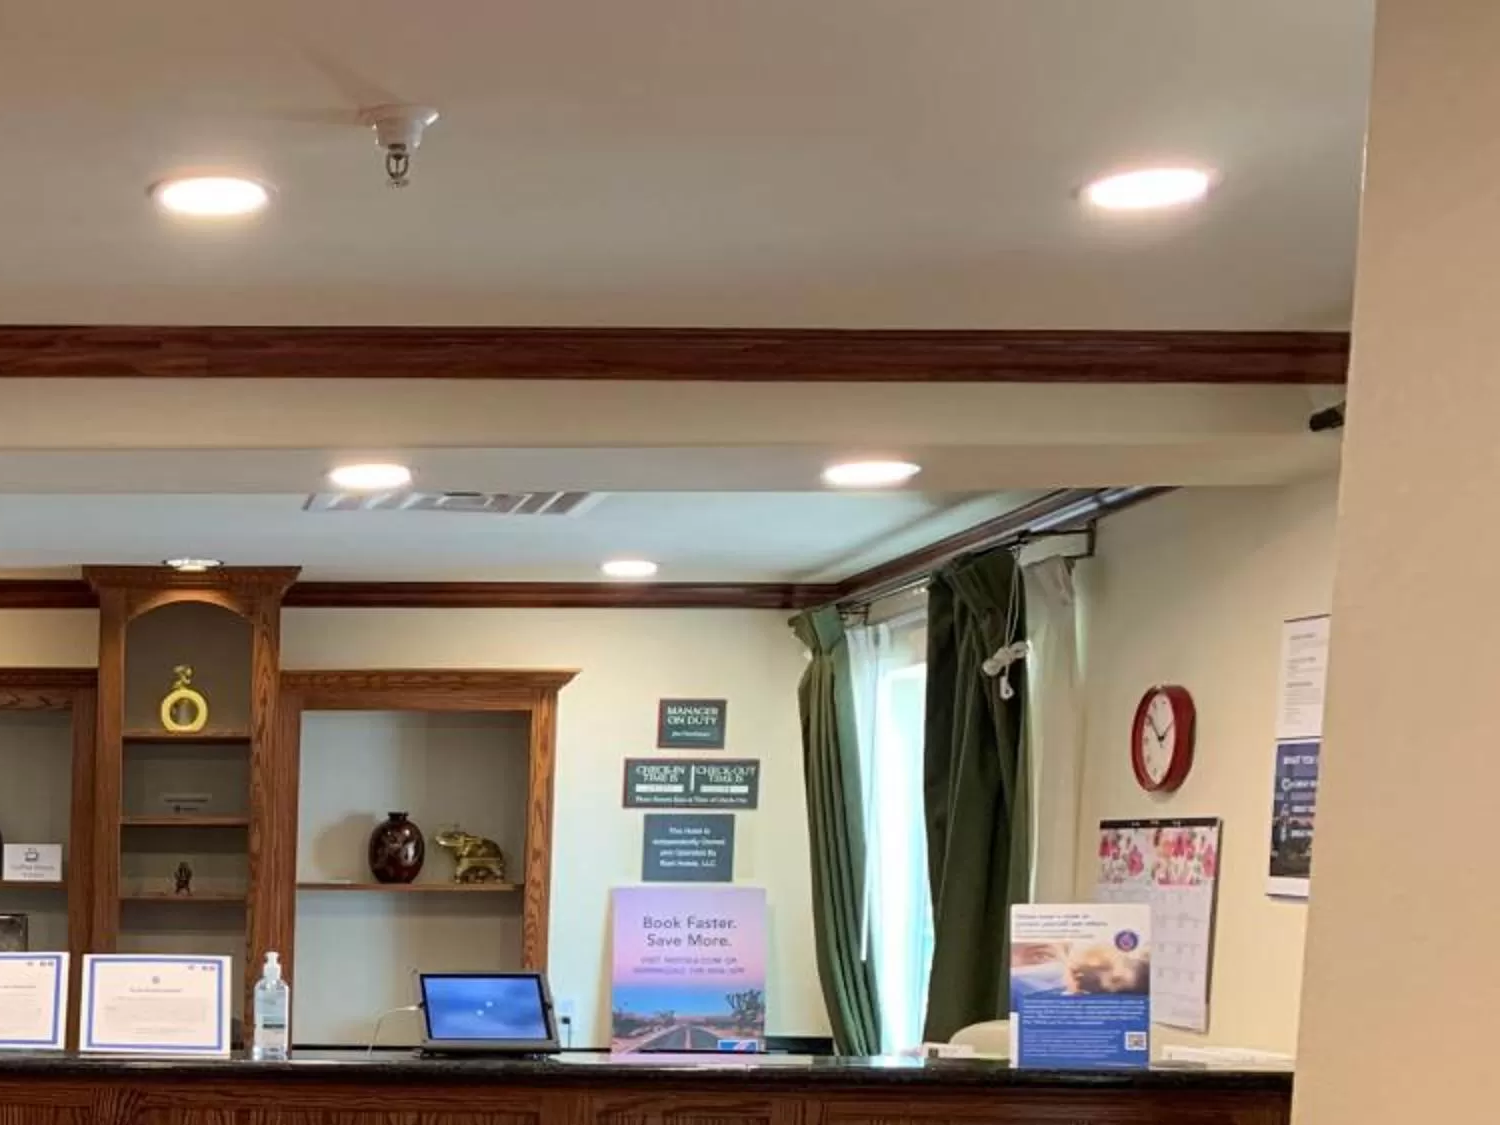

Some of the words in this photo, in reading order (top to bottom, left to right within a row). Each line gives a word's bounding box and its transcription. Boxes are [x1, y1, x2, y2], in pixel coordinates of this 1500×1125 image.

[666, 705, 719, 716] MANAGER
[666, 715, 685, 726] ON
[687, 715, 718, 726] DUTY
[643, 915, 681, 929] Book
[687, 915, 738, 929] Faster.
[647, 933, 682, 947] Save
[687, 933, 733, 947] More.
